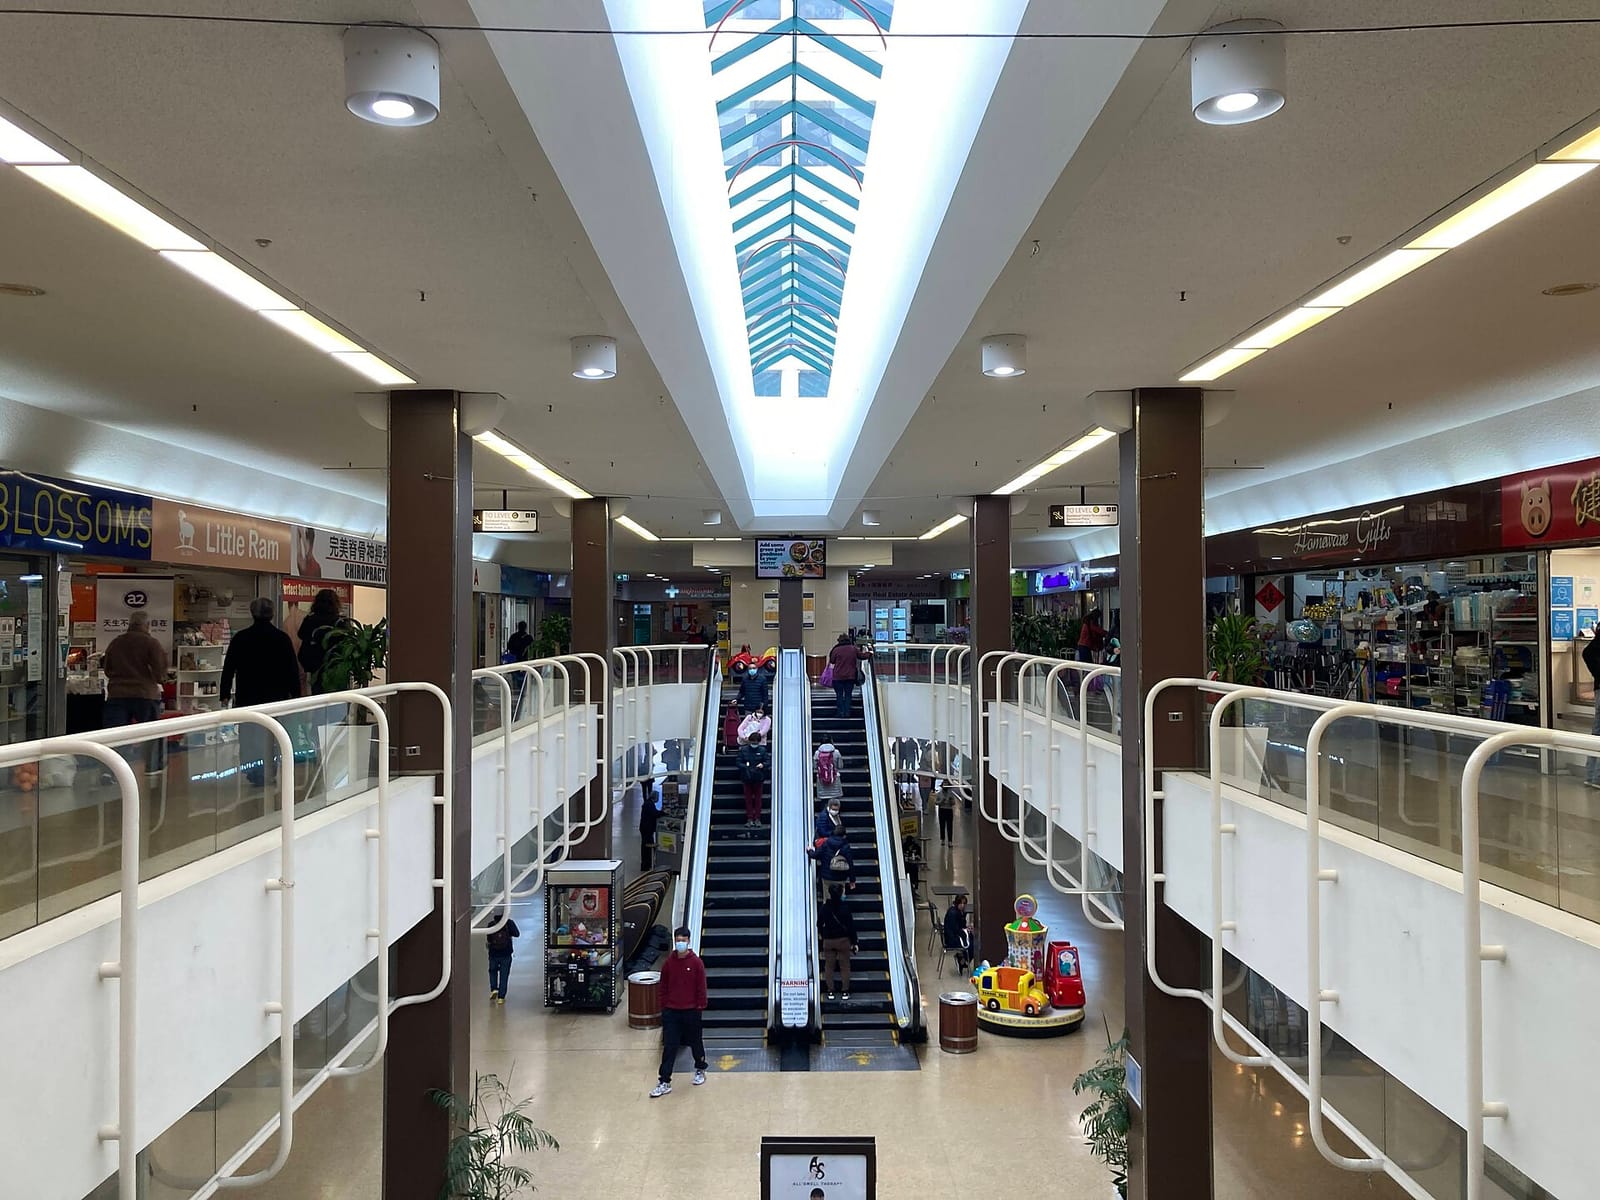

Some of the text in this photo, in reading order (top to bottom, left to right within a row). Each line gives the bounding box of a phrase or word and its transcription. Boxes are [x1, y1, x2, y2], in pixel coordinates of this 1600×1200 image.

[0, 482, 152, 549] BLOSSOMS
[1293, 509, 1392, 554] Homeware Gifts
[206, 521, 279, 561] Little Ram
[344, 562, 387, 582] CHIROPRACT
[127, 593, 145, 605] a2
